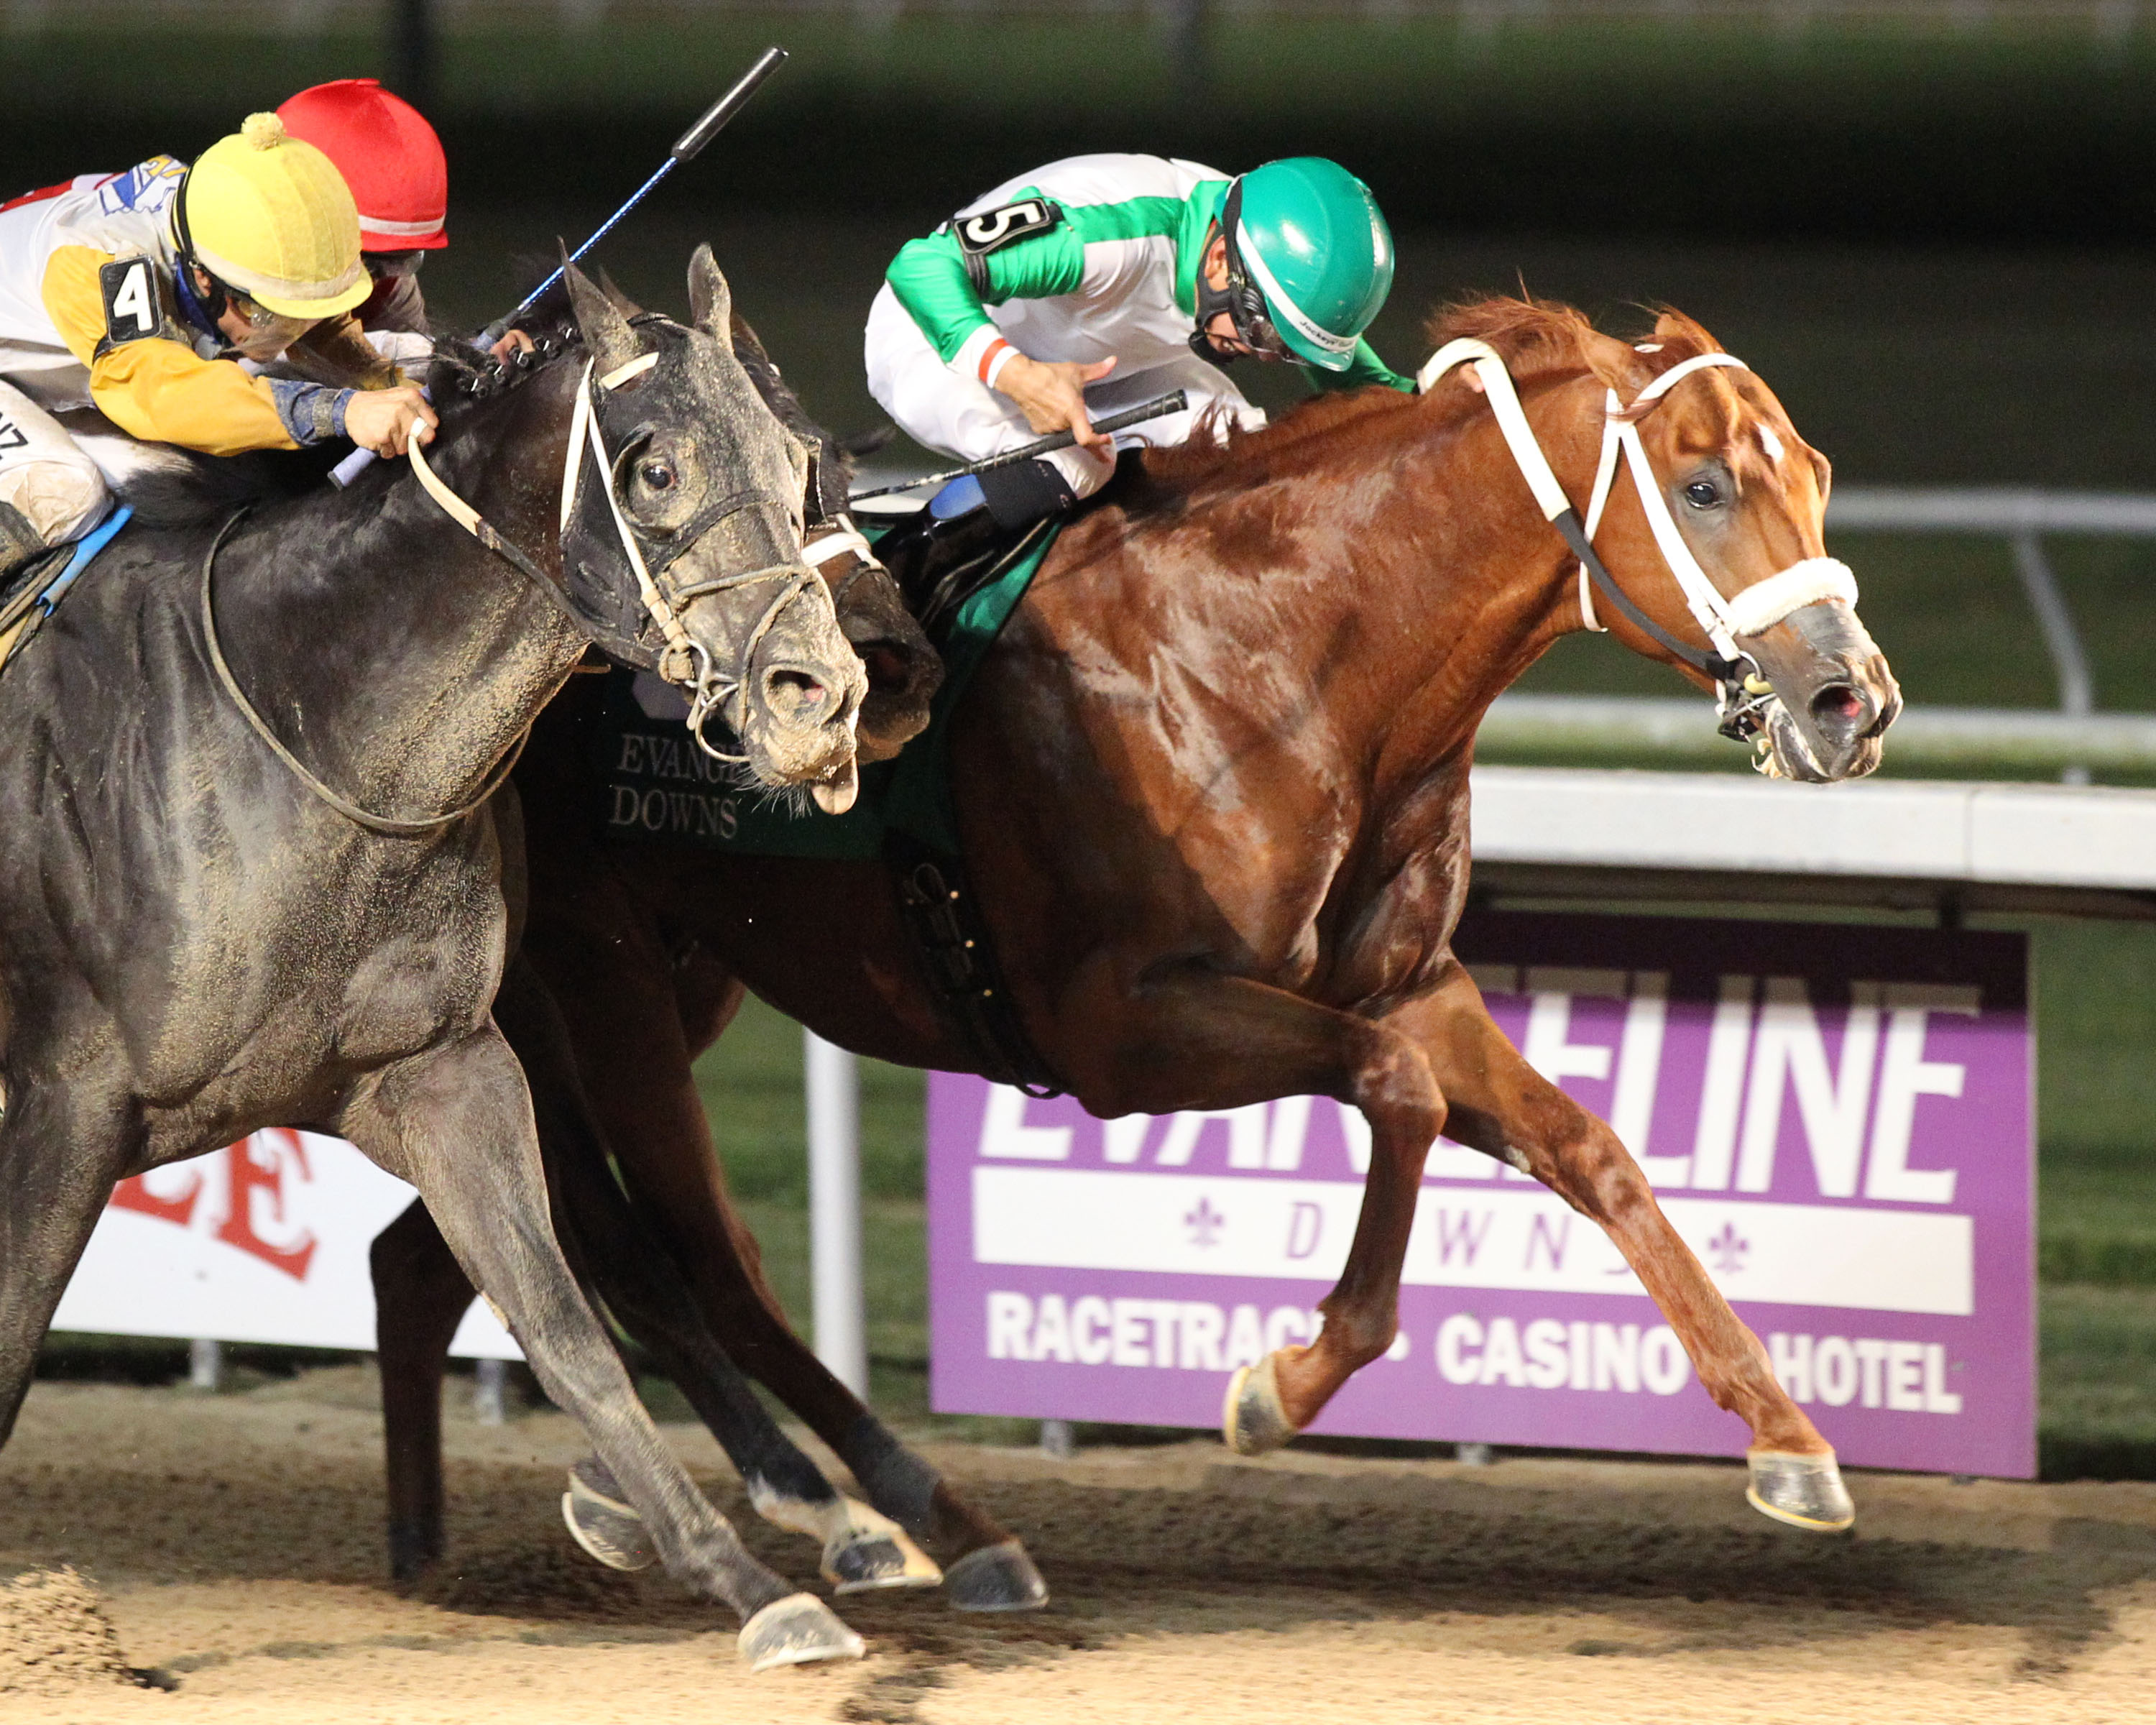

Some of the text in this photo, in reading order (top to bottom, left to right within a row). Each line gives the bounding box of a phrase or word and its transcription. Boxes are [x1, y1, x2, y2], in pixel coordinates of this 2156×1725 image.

[966, 203, 1041, 243] 5
[113, 262, 152, 331] 4
[609, 786, 737, 840] DOWNS
[1286, 1201, 1630, 1275] DWN
[1435, 1313, 1691, 1396] CASINO
[1769, 1332, 1963, 1414] HOTEL
